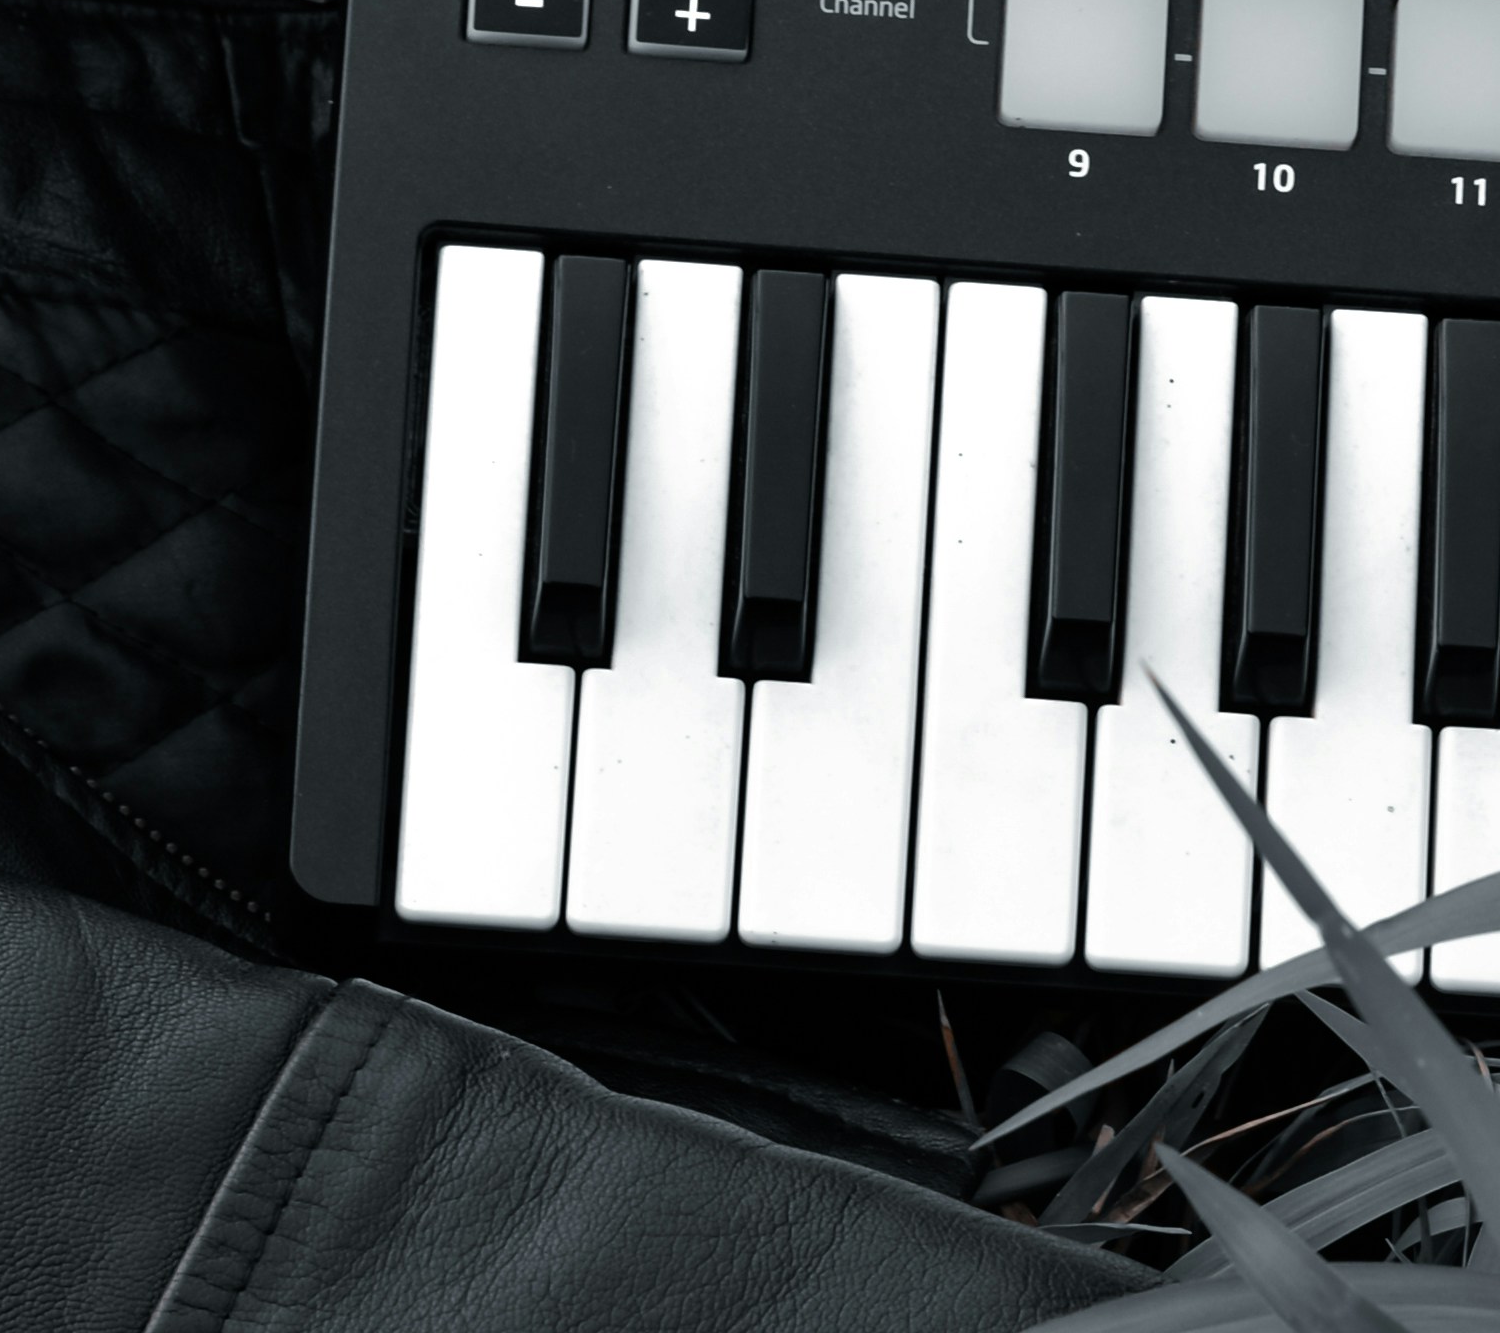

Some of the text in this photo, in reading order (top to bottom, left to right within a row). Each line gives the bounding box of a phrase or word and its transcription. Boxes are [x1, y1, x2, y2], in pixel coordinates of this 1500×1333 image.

[1068, 148, 1090, 178] 9
[1253, 162, 1295, 193] 10
[1450, 176, 1487, 207] 11
